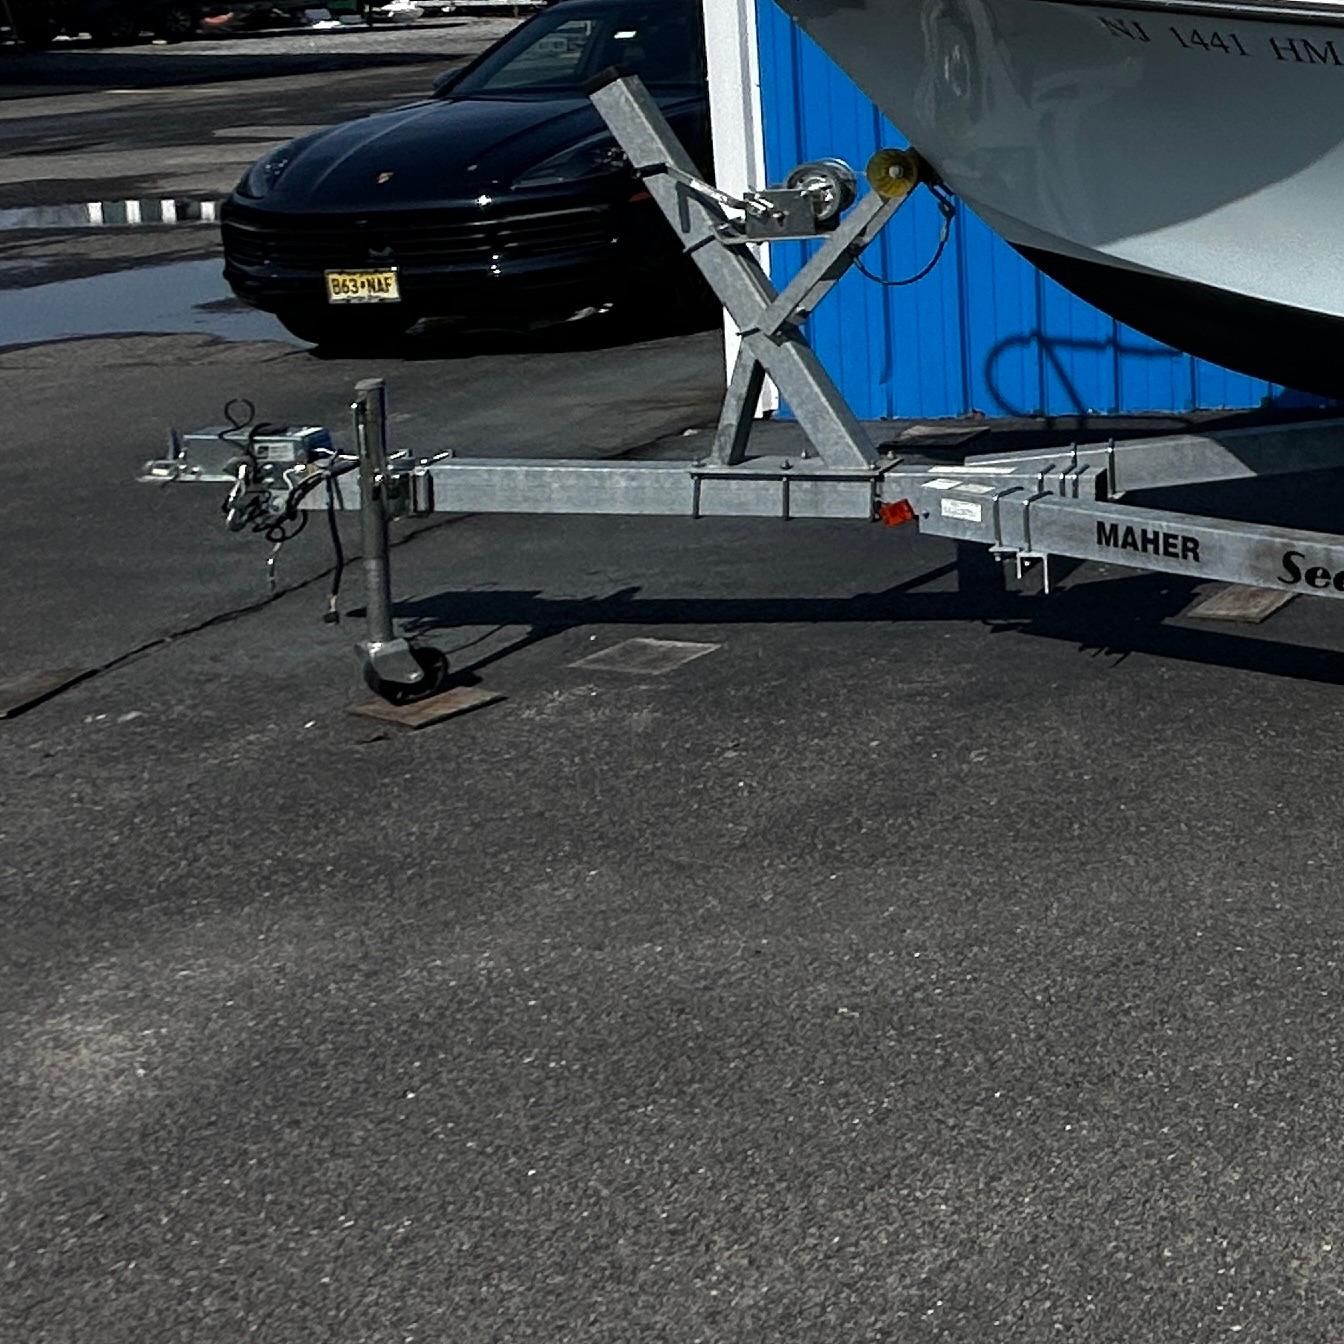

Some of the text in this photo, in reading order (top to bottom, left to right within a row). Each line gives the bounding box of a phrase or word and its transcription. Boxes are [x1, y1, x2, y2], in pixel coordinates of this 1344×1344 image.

[1099, 16, 1151, 43] NJ
[1169, 25, 1253, 58] 1441
[1096, 520, 1201, 563] MAHER
